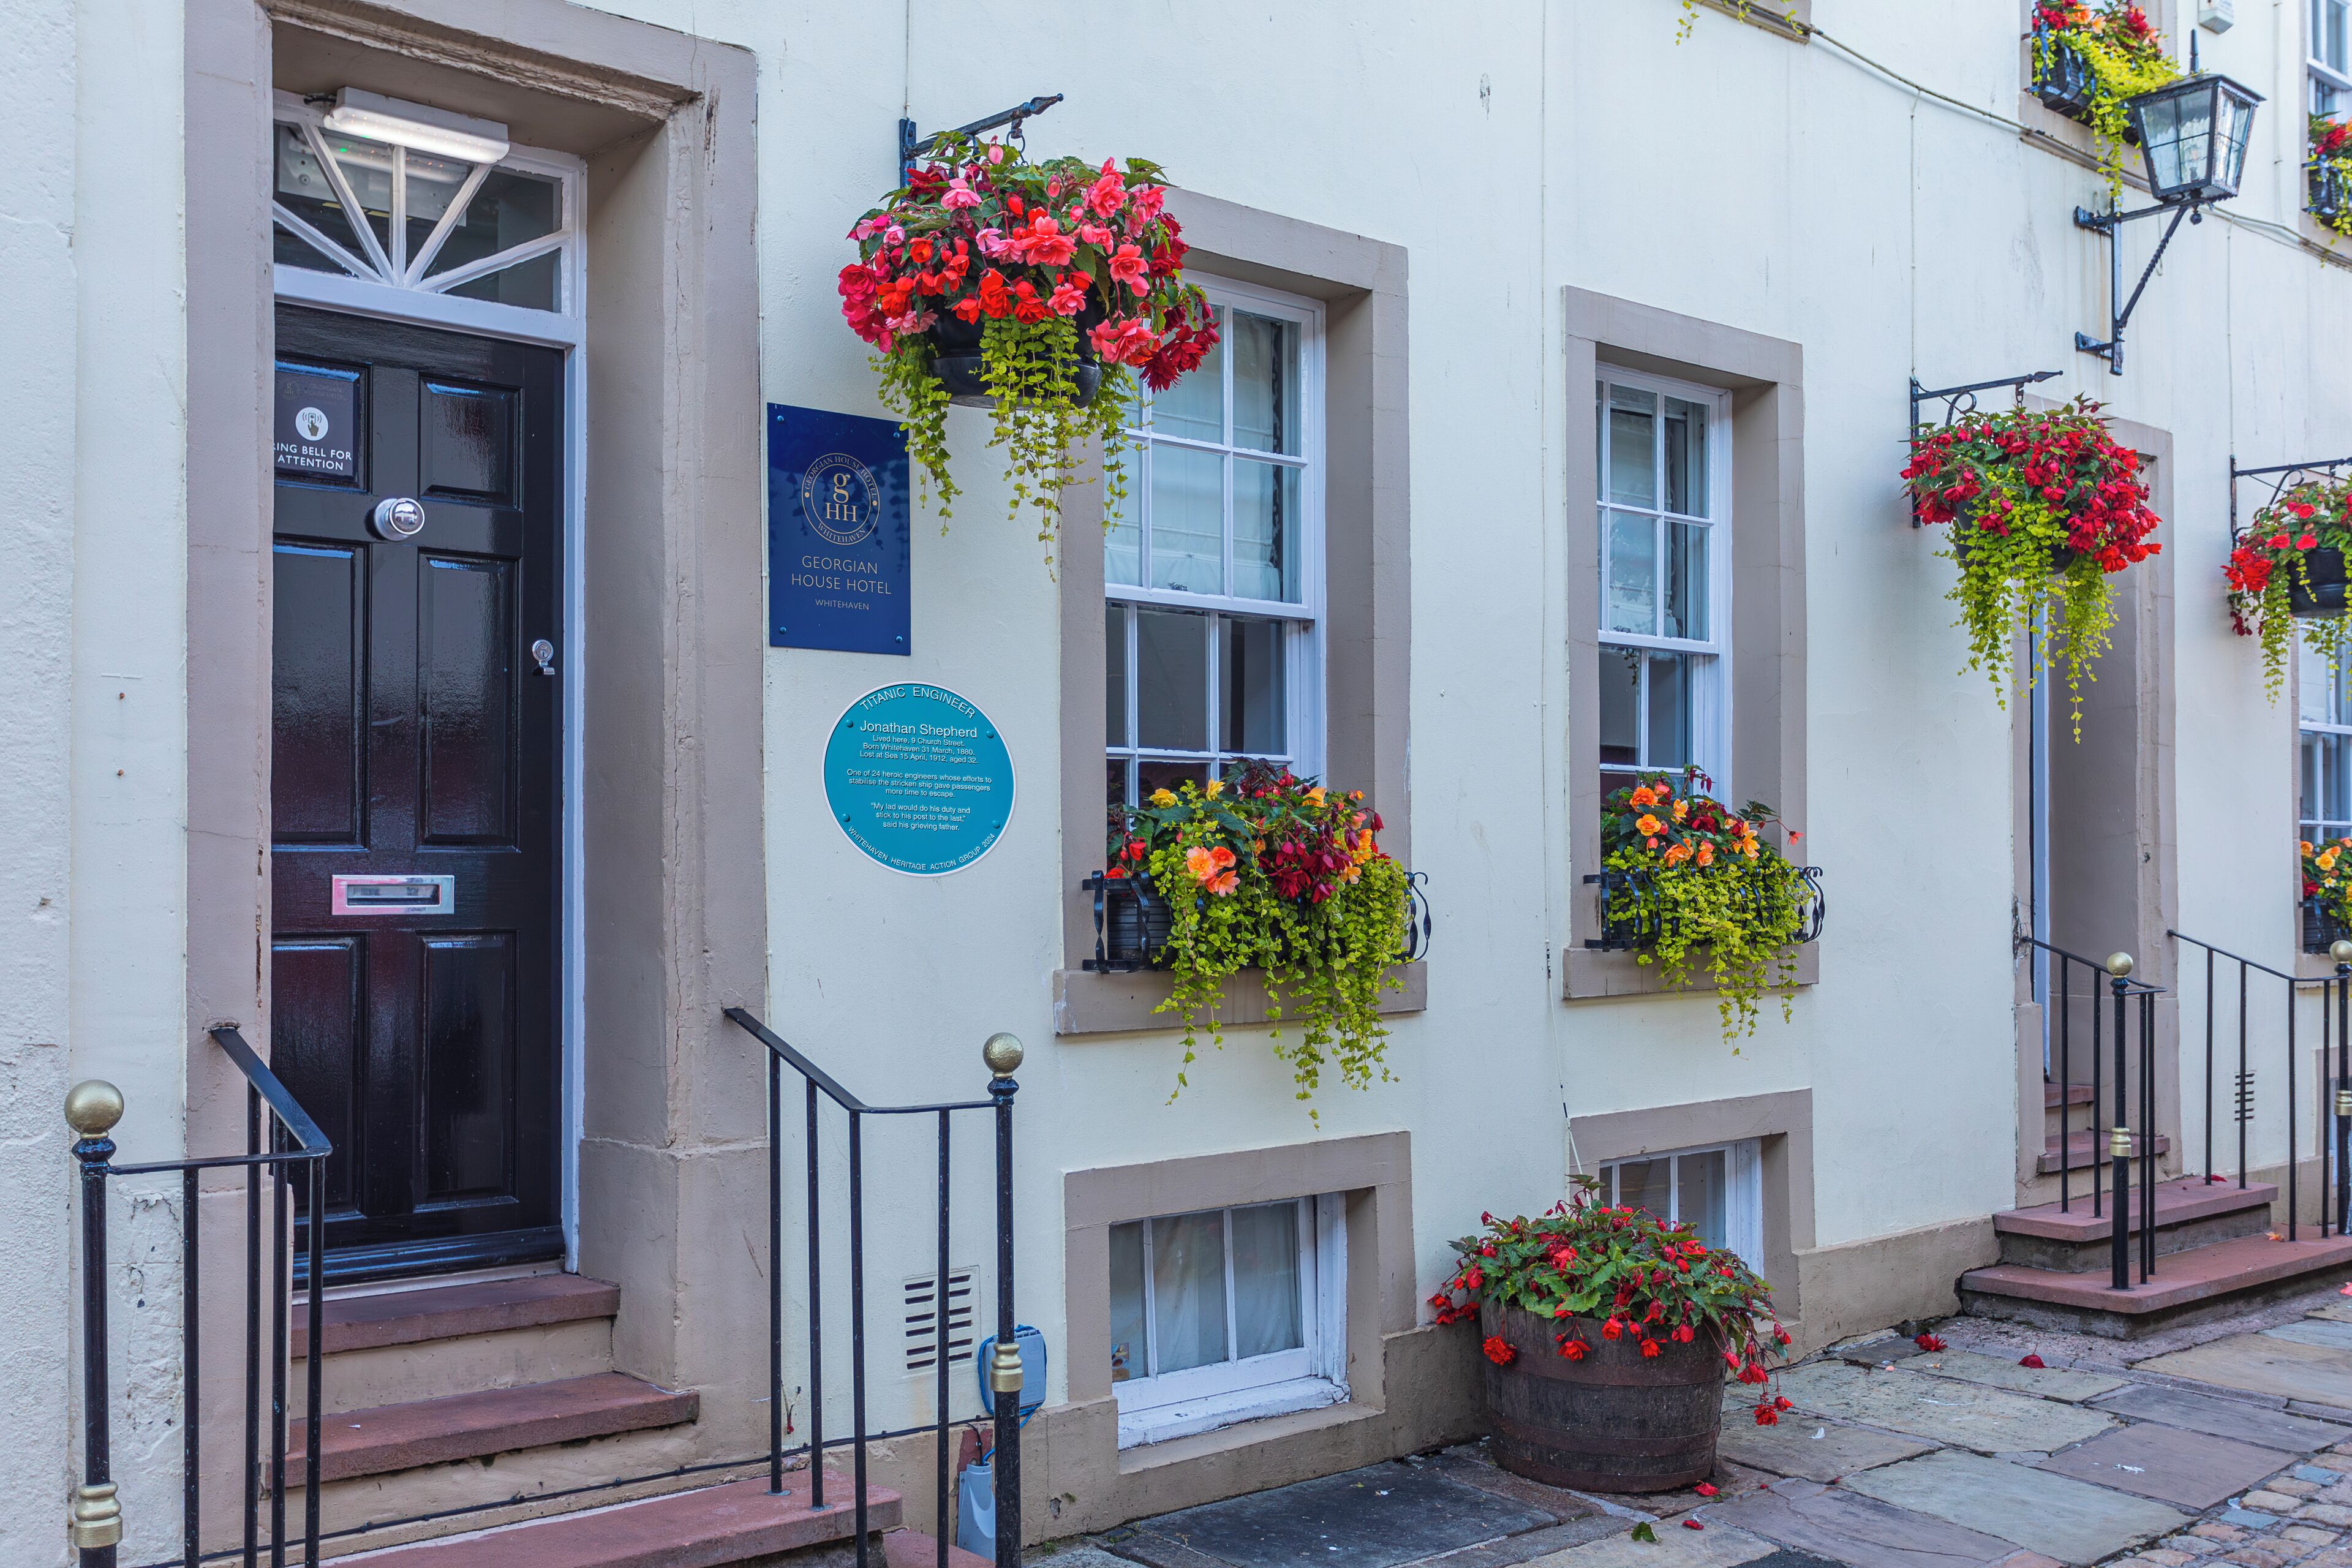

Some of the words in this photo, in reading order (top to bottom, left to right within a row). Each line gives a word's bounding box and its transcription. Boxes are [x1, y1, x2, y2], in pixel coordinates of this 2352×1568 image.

[277, 454, 343, 470] ATTENTION
[302, 446, 326, 457] BELL
[331, 450, 352, 461] FOR
[805, 456, 832, 489] GEORGIAN
[835, 456, 861, 469] HOUSE
[861, 469, 876, 496] HOTEL
[825, 502, 858, 522] HH
[818, 523, 865, 542] WHITEHAVEN
[802, 556, 877, 574] GEORGIAN
[792, 573, 840, 589] HOUSE
[847, 578, 891, 594] HOTEL
[815, 598, 869, 610] WHITEHAVEN
[860, 687, 905, 710] TITANIC
[913, 687, 975, 718] ENGINEER
[861, 720, 916, 734] Jonathan
[920, 724, 977, 738] Shepherd
[911, 823, 937, 831] grieving
[848, 826, 889, 861] WHITEHAVEN
[891, 859, 927, 870] HERITAGE
[930, 859, 957, 870] ACTION
[959, 846, 981, 864] GROUP
[982, 833, 995, 848] 2024
